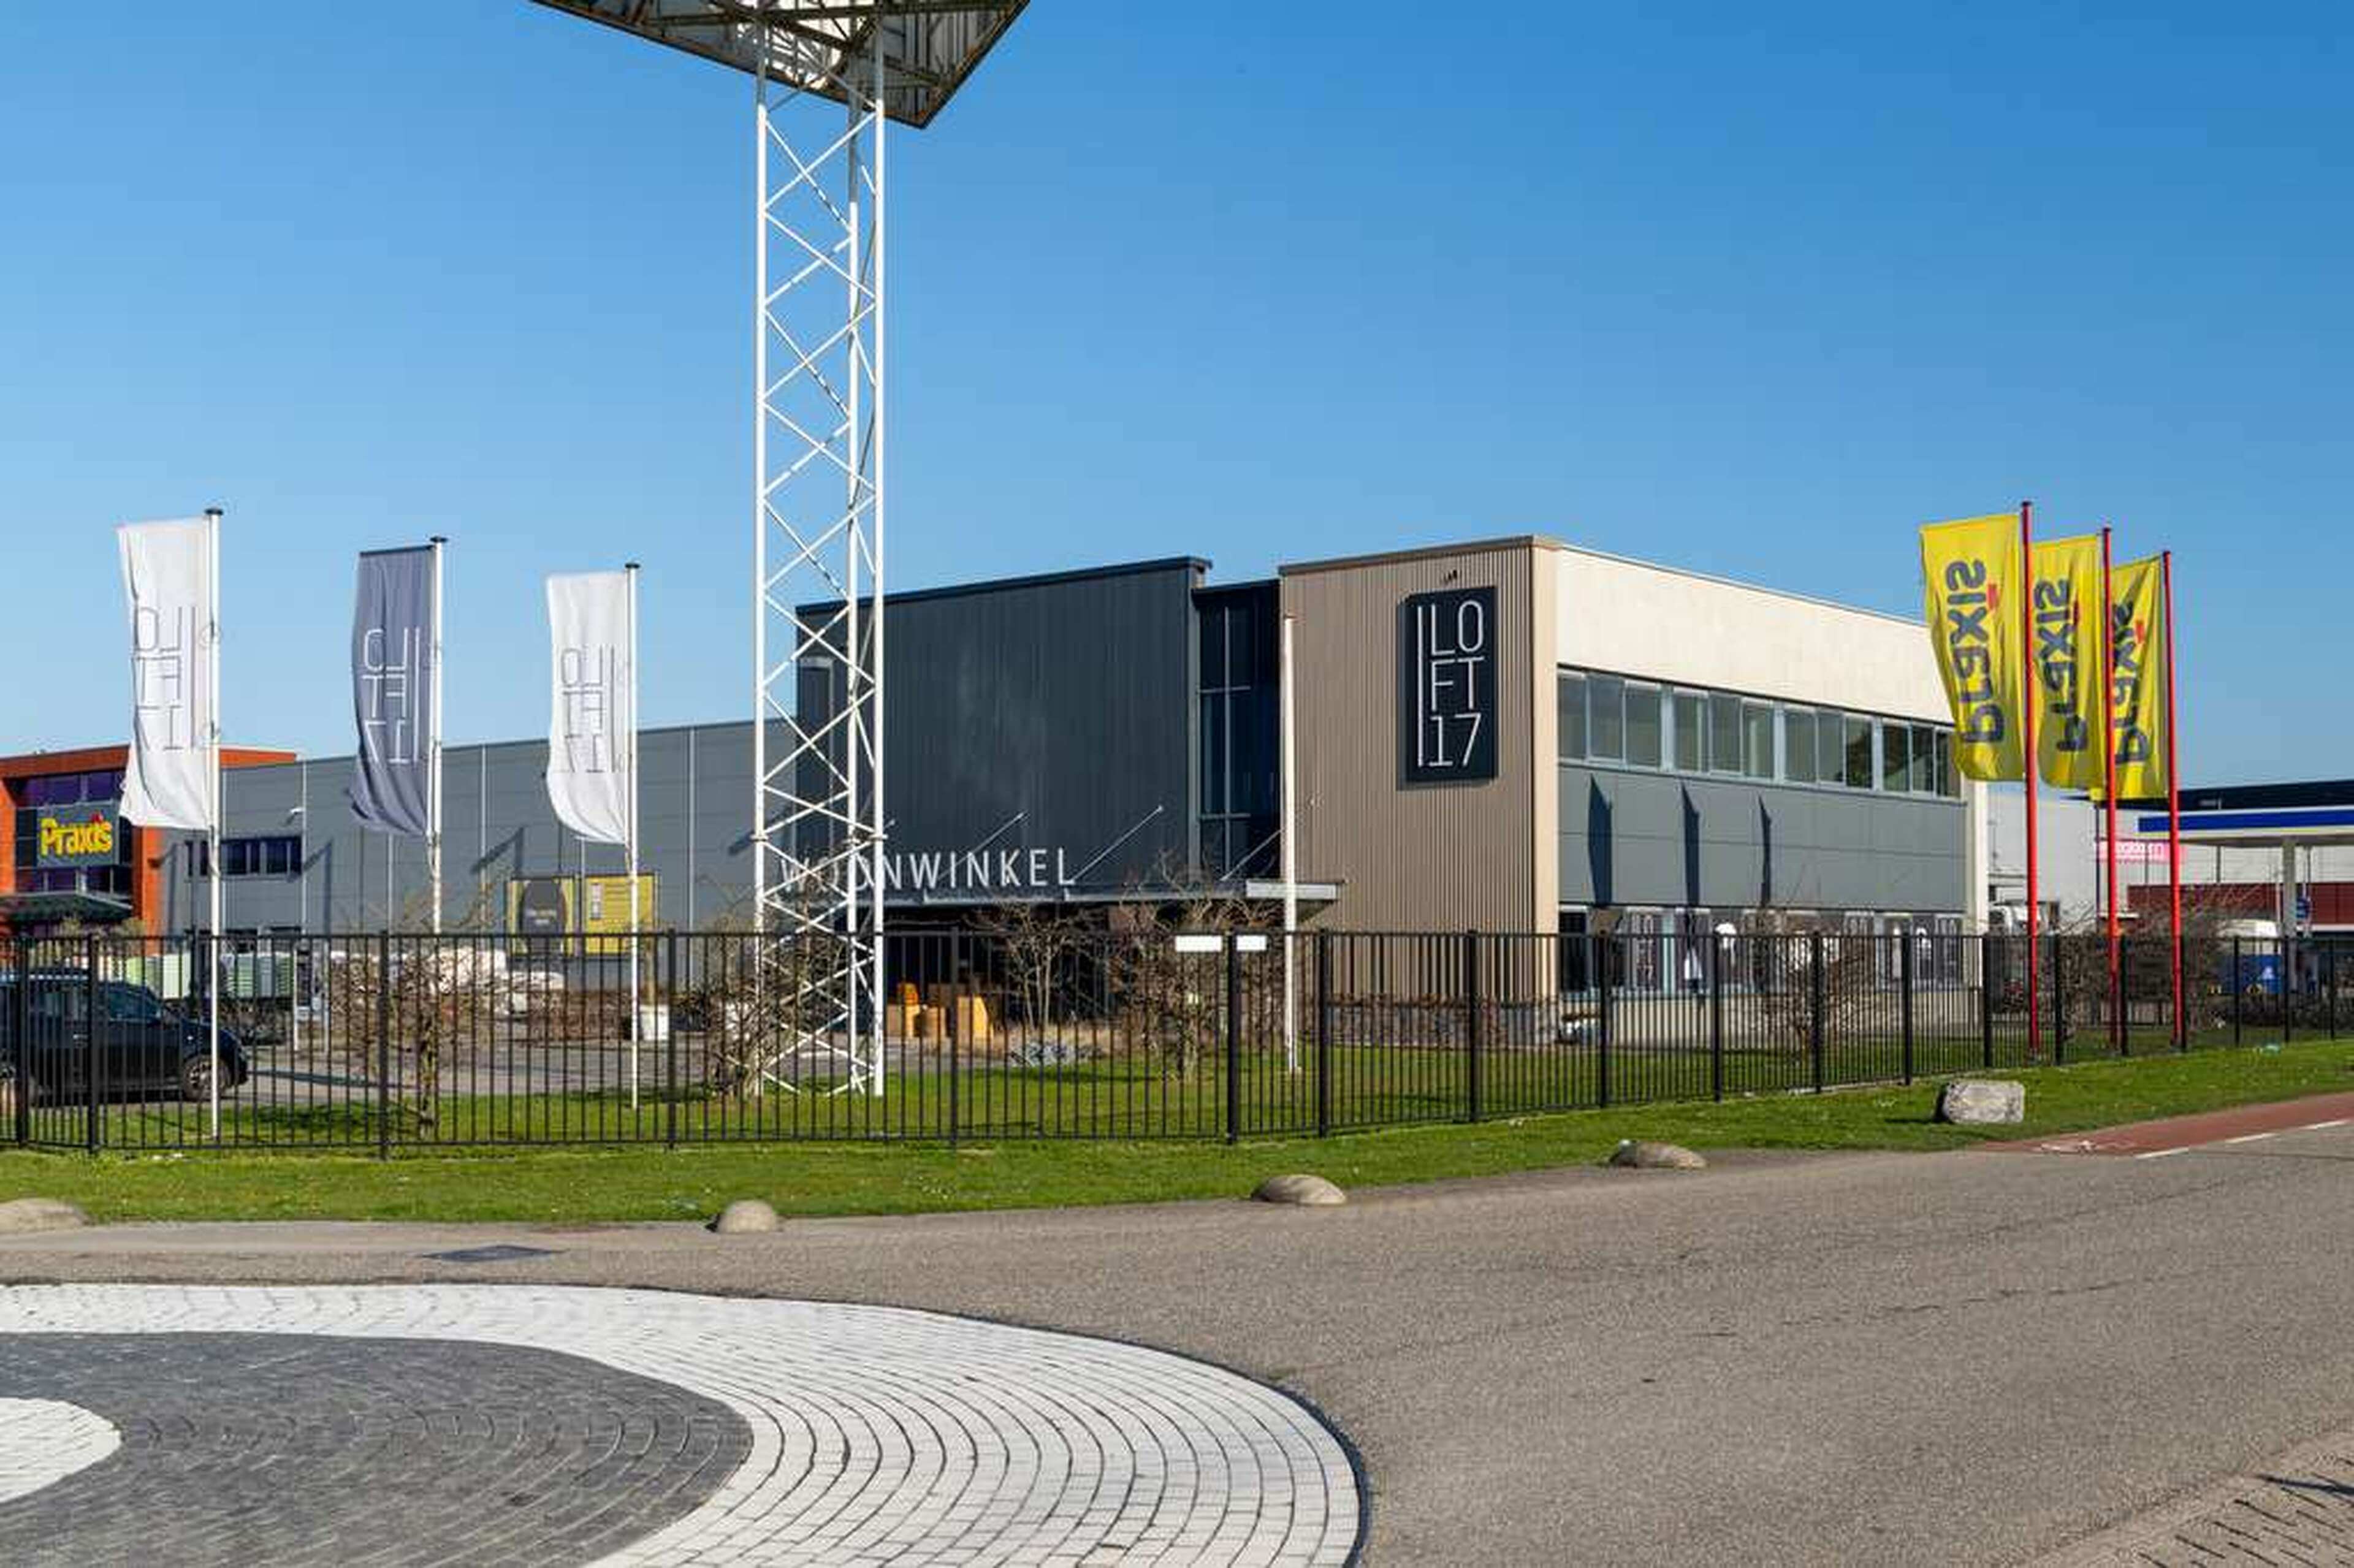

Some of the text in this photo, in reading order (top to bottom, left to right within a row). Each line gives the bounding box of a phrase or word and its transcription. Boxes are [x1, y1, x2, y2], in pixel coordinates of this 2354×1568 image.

[1431, 600, 1484, 656] LO
[1430, 655, 1485, 712] FT
[1428, 712, 1482, 767] 17
[40, 812, 113, 856] Praxis
